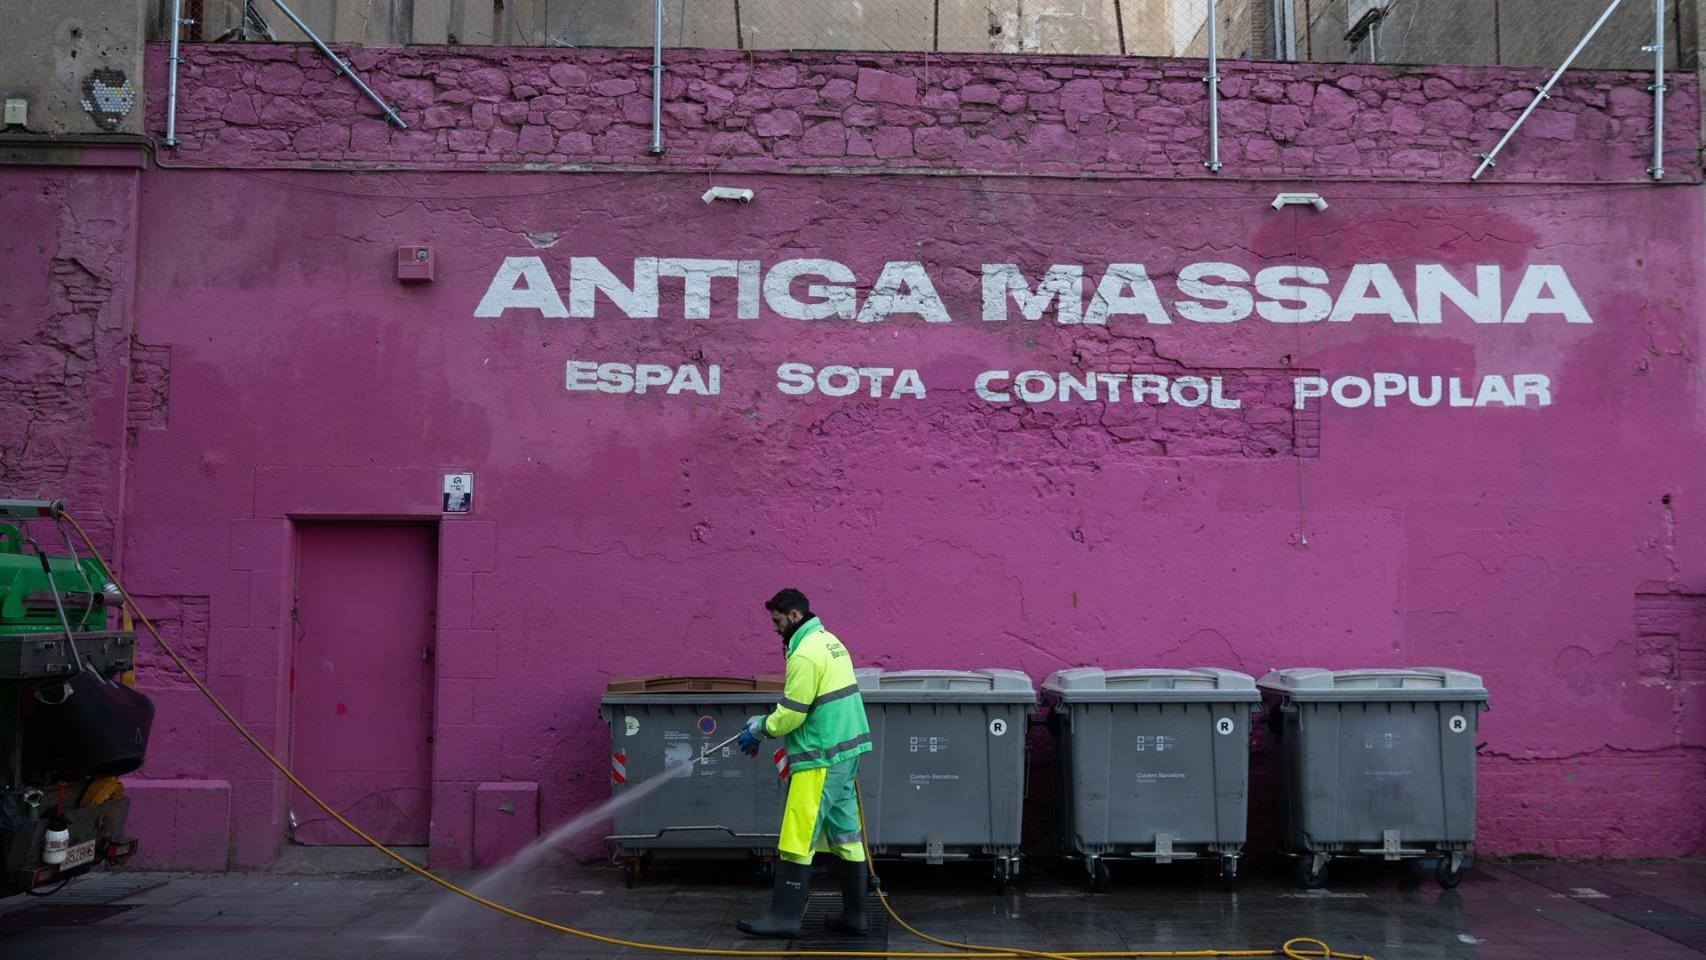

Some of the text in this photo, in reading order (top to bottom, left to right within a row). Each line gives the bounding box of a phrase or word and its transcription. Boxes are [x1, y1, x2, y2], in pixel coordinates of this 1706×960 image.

[474, 256, 1594, 325] ANTIGA MASSANA
[565, 360, 1552, 410] ESPAI SOTA CONTROL POPULAR
